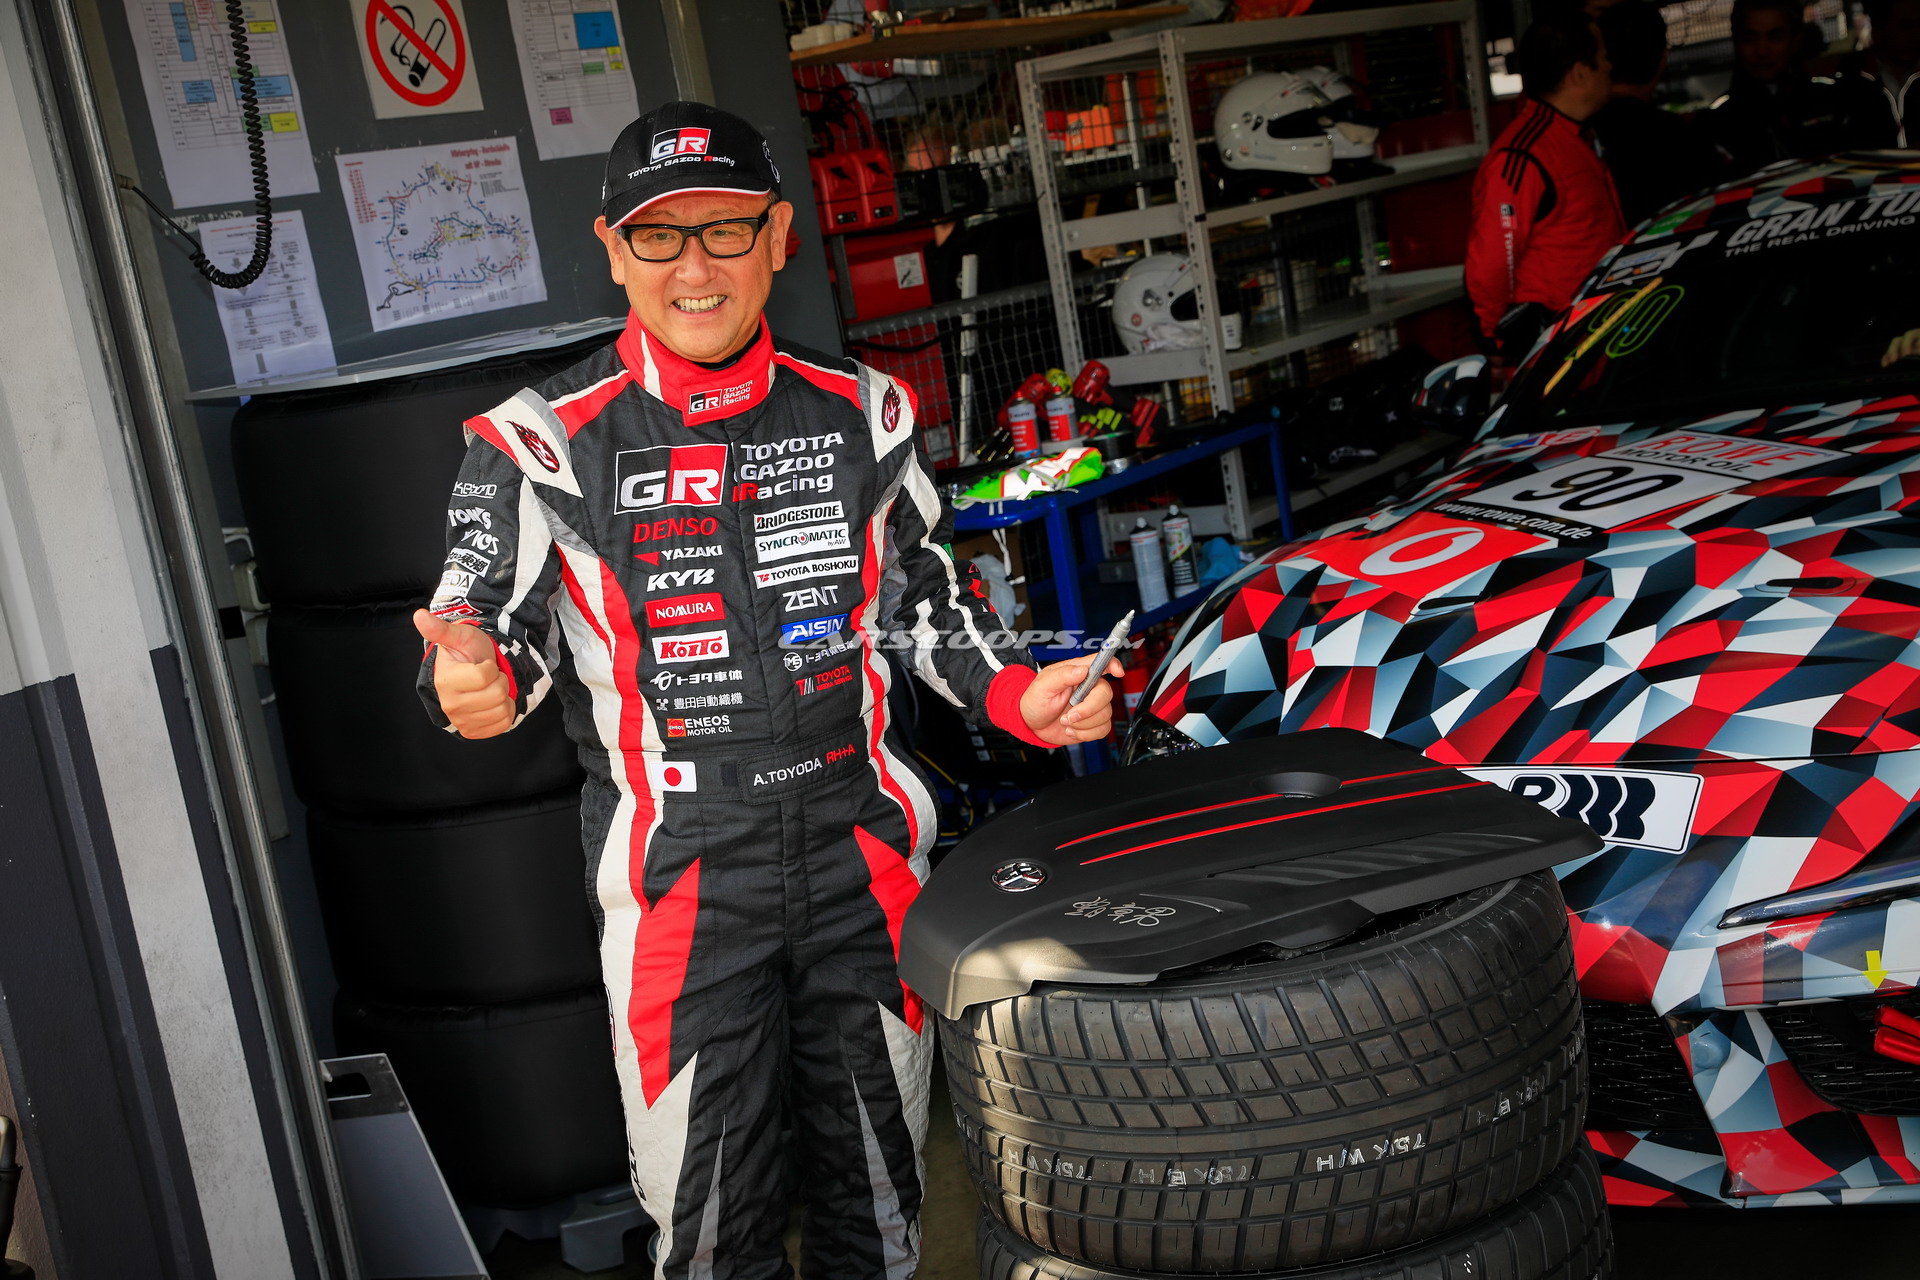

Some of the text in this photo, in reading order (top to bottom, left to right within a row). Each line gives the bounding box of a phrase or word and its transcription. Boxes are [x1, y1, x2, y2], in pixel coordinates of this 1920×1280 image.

[652, 136, 707, 160] GR
[627, 155, 736, 180] TOYOTA GAZOO Racing
[1725, 200, 1856, 248] GRAN
[1724, 215, 1916, 258] THE REAL DRIVING
[722, 387, 751, 399] GAZOO
[723, 380, 753, 394] TOYOTA
[690, 396, 719, 412] GR
[722, 393, 751, 406] Racing
[741, 432, 844, 461] TOYOTA
[1636, 435, 1818, 467] ROWE
[734, 453, 835, 483] GAZOO
[1622, 447, 1756, 474] MOTOR OIL
[620, 469, 721, 508] GR
[732, 473, 835, 503] Racing
[1512, 466, 1684, 512] 90
[756, 505, 840, 530] BRIDGESTONE
[1433, 502, 1594, 540] www.rowe.com.de
[633, 517, 718, 543] DENSO
[661, 545, 723, 561] YAZAKI
[647, 568, 715, 592] KYB
[770, 565, 810, 581] TOYOTA
[811, 559, 857, 573] BOSHOKU
[655, 601, 714, 620] NOMURA
[782, 585, 838, 612] ZENT
[790, 617, 846, 641] AISIN
[677, 669, 743, 686] トヨタ車体
[815, 665, 851, 684] TOYOTA
[673, 692, 744, 710] 豊田自動織機
[684, 715, 730, 728] ENEOS
[687, 725, 733, 737] MOTOR OIL
[753, 743, 856, 786] A.TOYODA RH+A
